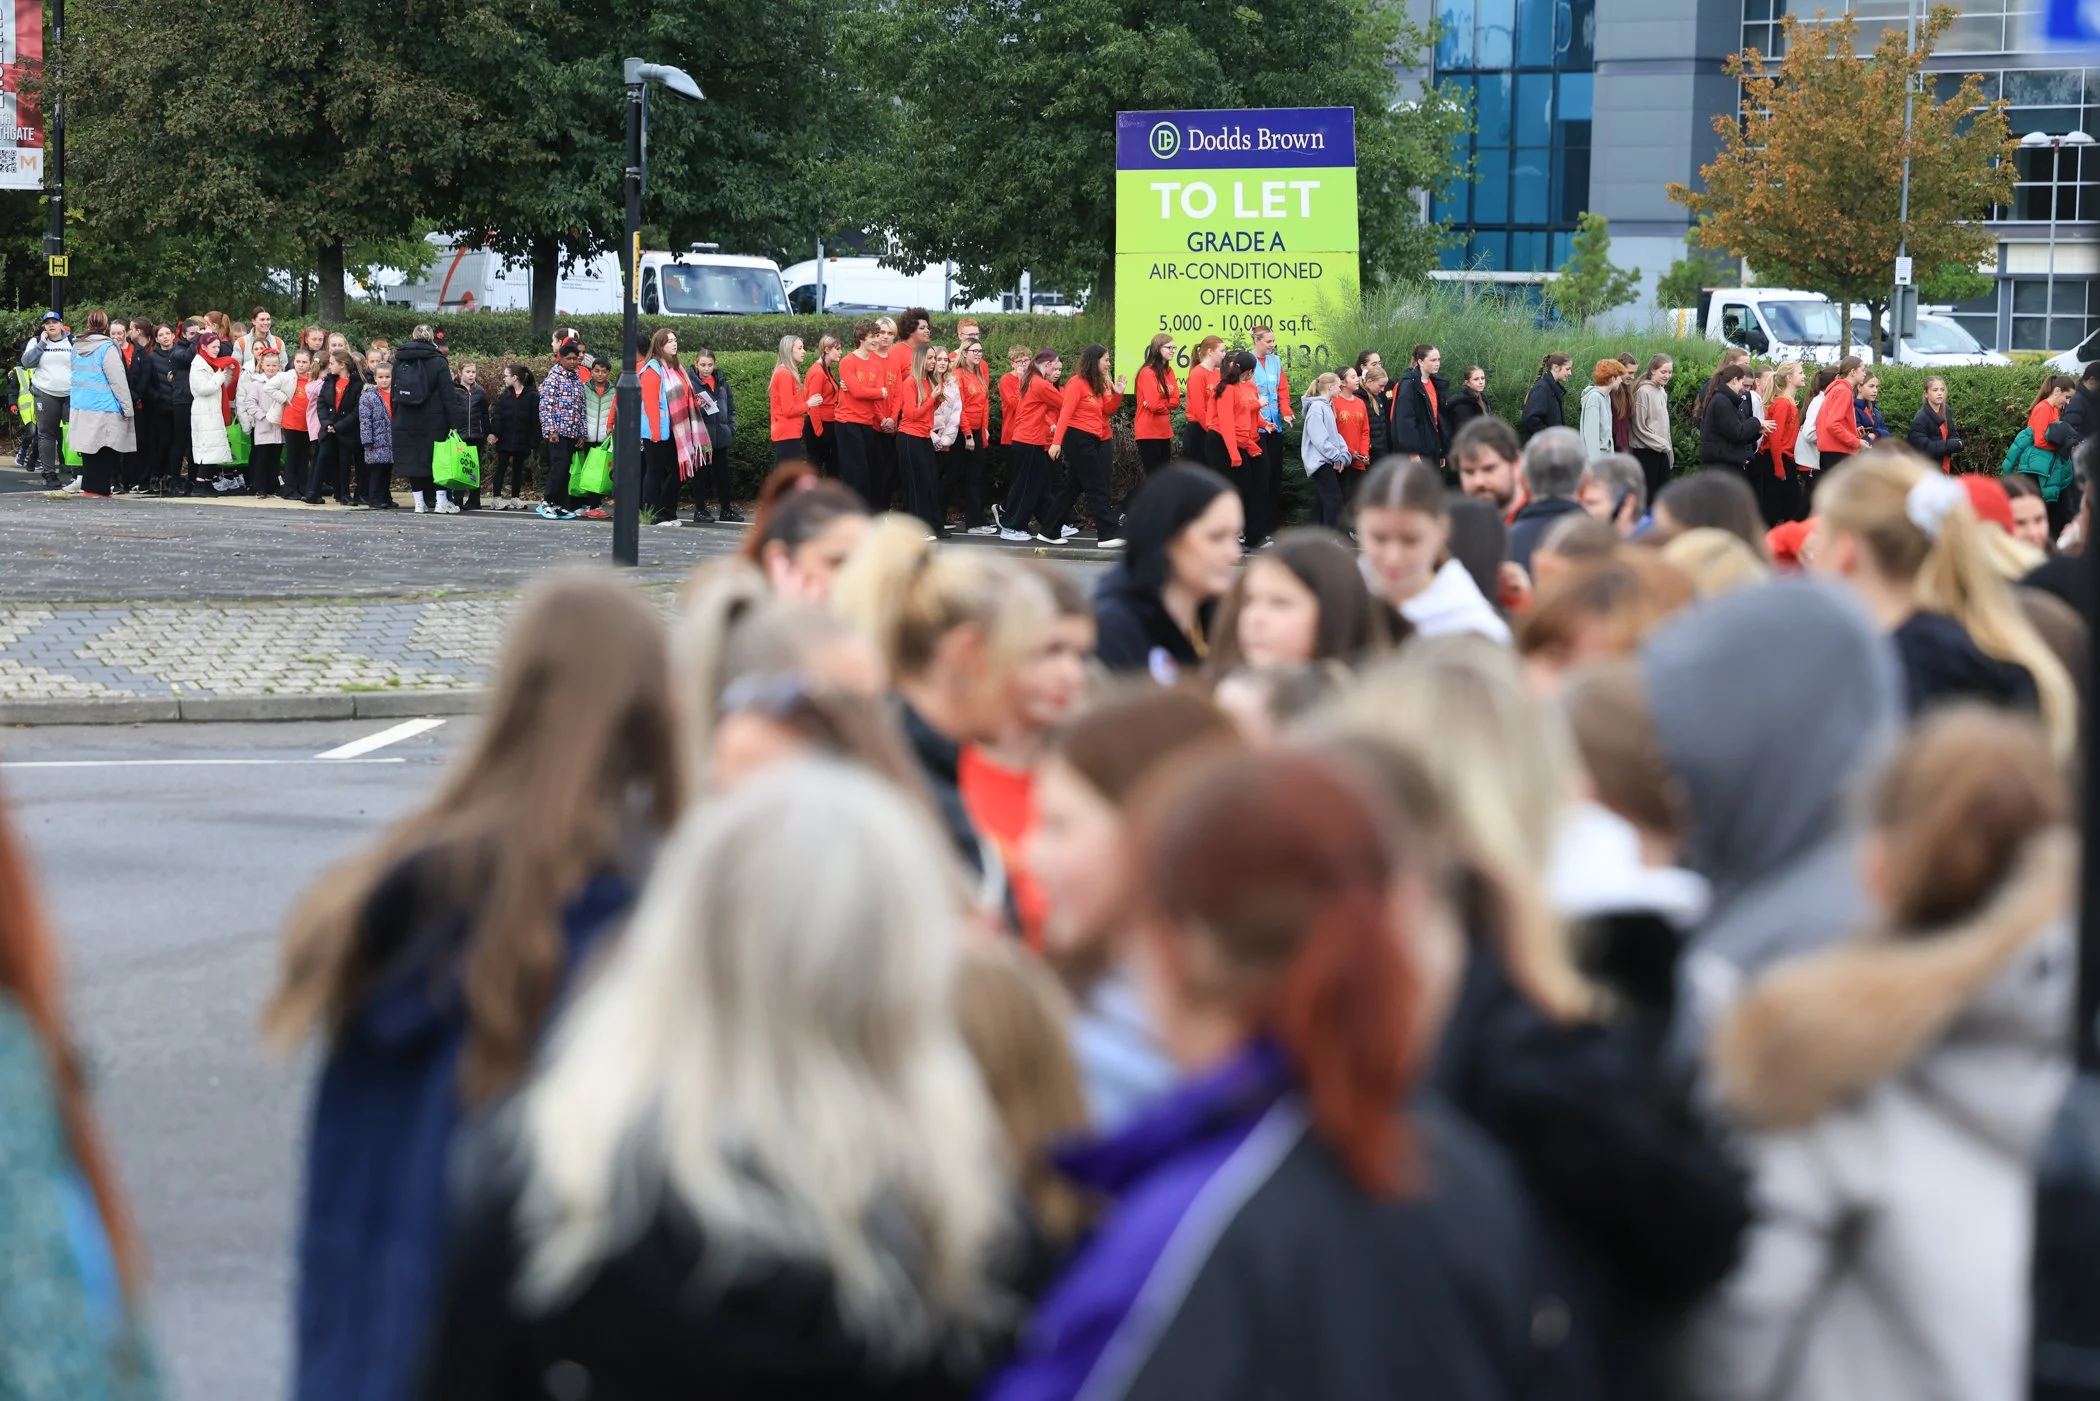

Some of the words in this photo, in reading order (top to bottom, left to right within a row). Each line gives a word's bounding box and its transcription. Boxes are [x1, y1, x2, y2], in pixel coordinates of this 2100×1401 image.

[1188, 127, 1251, 151] Dodds
[1257, 128, 1325, 150] Brown
[1150, 181, 1217, 219] TO
[1234, 180, 1321, 219] LET
[1187, 231, 1265, 252] GRADE
[1269, 231, 1286, 252] A
[1149, 262, 1323, 280] AIR-CONDITIONED
[1200, 288, 1272, 306] OFFICES
[1159, 314, 1202, 333] 5,000
[1222, 314, 1273, 333] 10,000
[1279, 314, 1317, 336] sq.ft.
